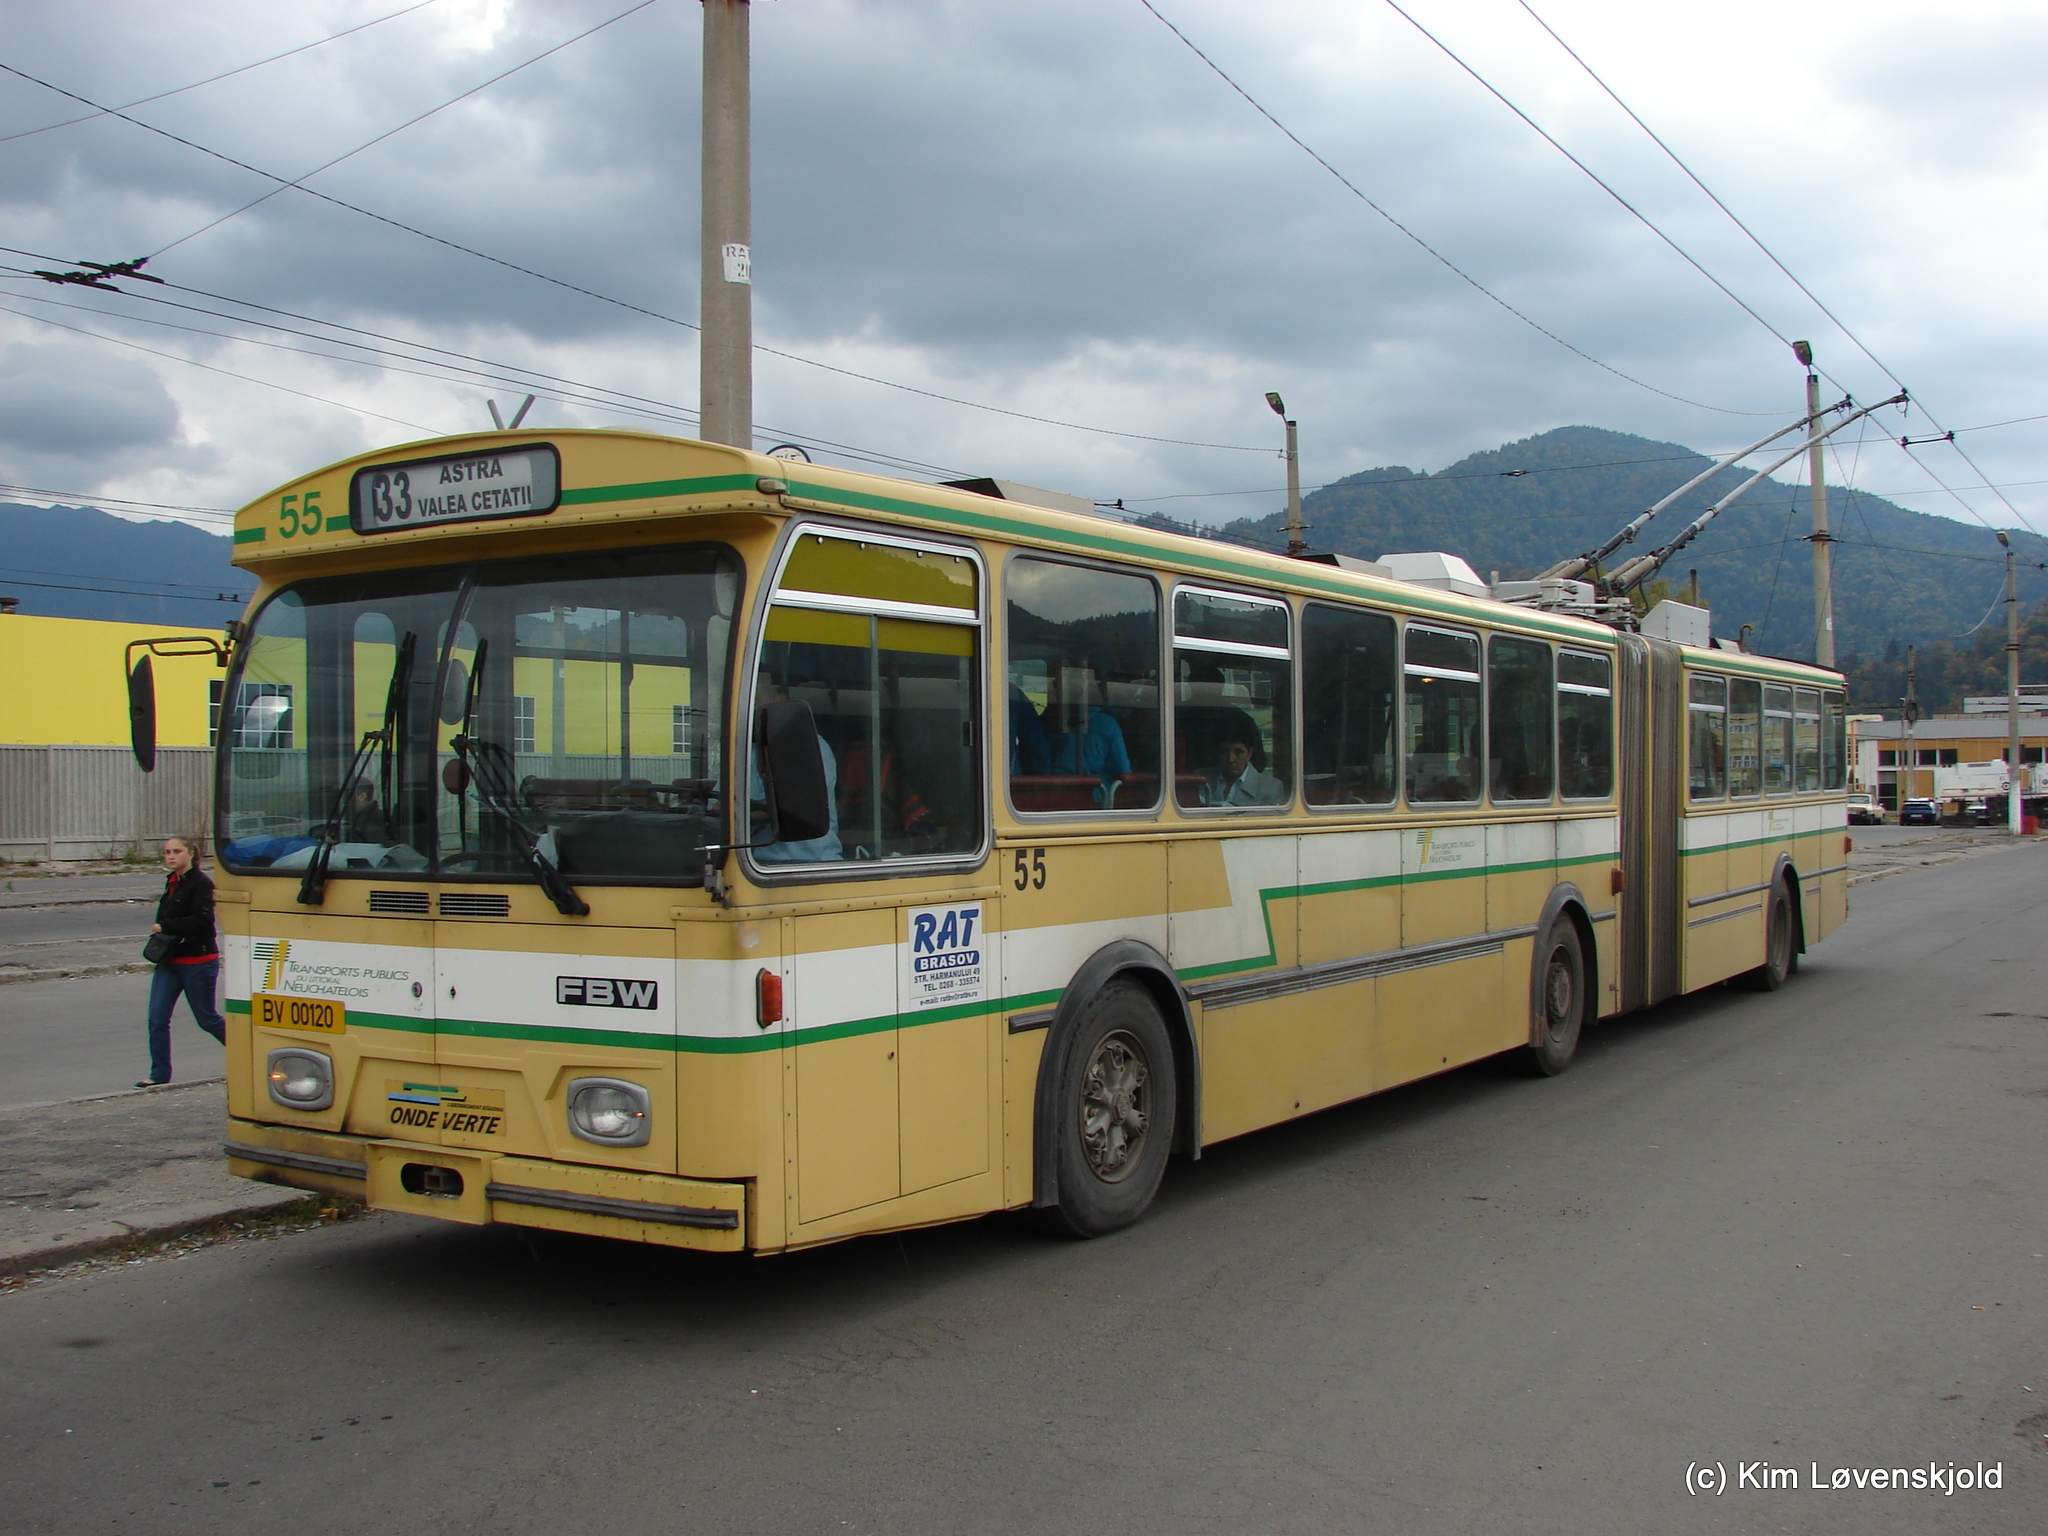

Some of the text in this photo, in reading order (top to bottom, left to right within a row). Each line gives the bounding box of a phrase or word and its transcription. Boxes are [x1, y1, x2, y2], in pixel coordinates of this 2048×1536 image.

[439, 458, 503, 485] ASTRA
[278, 491, 323, 539] 55
[418, 485, 532, 517] VALEA CETATII
[1014, 848, 1046, 891] 55
[913, 908, 979, 954] RAT
[920, 952, 975, 971] BRASOV
[557, 976, 656, 1008] FBW
[914, 974, 928, 984] STR.
[923, 983, 938, 992] TEL.
[939, 980, 954, 990] 0268
[262, 999, 334, 1028] BV 00120
[390, 1106, 501, 1134] ONDE VERTE
